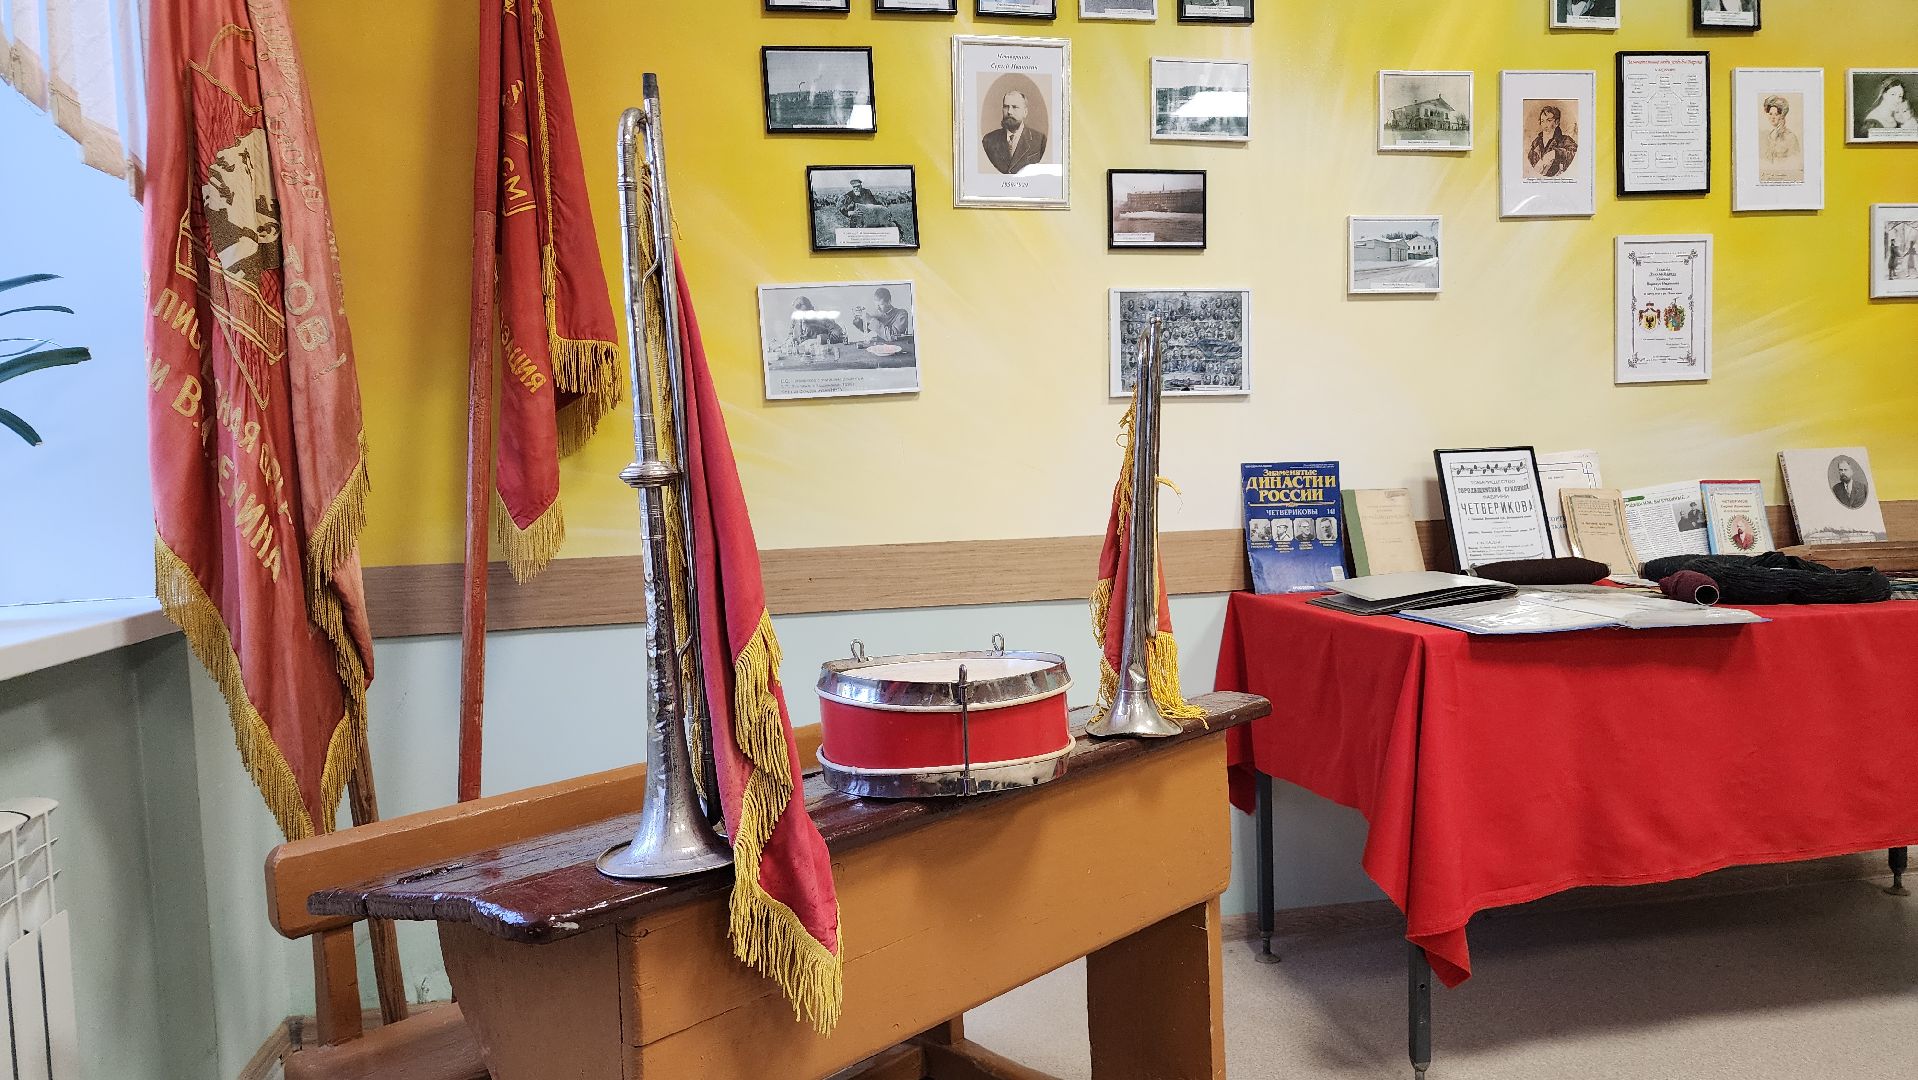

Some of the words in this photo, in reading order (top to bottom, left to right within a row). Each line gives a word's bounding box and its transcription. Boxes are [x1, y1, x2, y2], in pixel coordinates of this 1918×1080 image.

[1246, 475, 1337, 491] ДИНАСТИИ
[1258, 488, 1324, 502] РОССИИ
[1265, 508, 1319, 516] ЧЕТВЕРИКОВЫ
